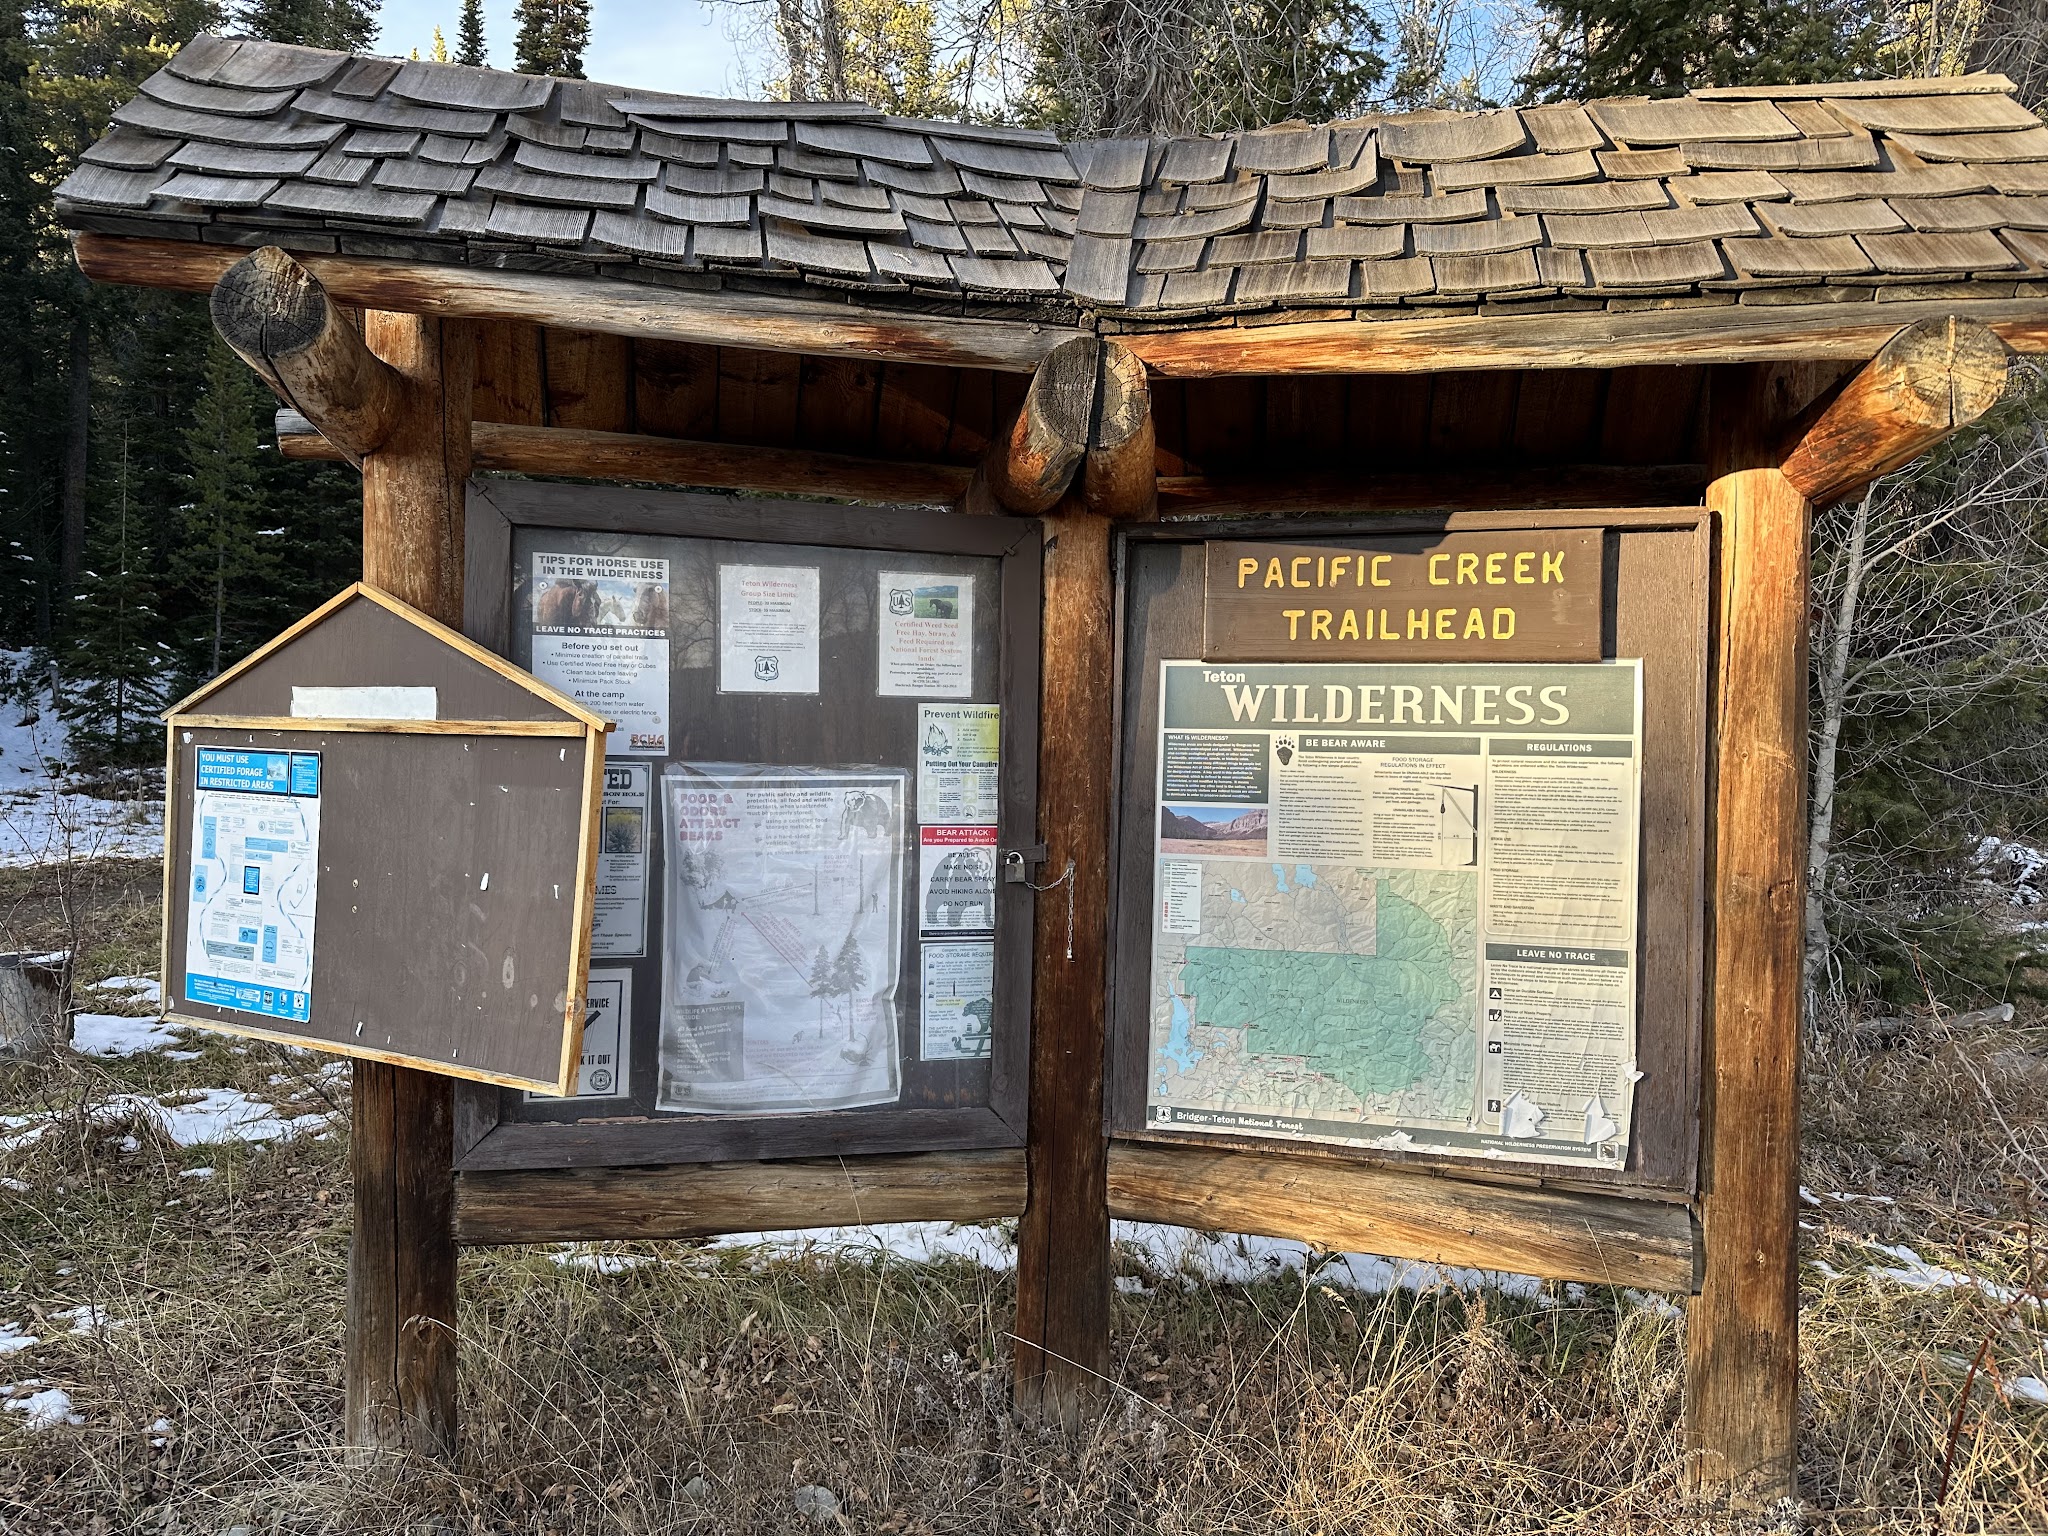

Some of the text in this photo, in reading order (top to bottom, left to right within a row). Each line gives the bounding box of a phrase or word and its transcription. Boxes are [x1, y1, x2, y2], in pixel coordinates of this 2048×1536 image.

[538, 556, 664, 570] TIPS FOR HORSE USE
[542, 566, 664, 580] IN THE WILDERNESS
[1238, 550, 1565, 588] PACIFIC CREEK
[1282, 607, 1516, 641] TRAILHEAD
[1203, 670, 1246, 683] Teton
[1221, 684, 1570, 726] WILDERNESS
[924, 710, 960, 719] Prevent
[1350, 740, 1386, 748] AWARE
[1527, 743, 1592, 752] REGULATIONS
[202, 753, 249, 764] YOU MUST USE
[201, 765, 263, 776] CERTIFIED FORAGE
[201, 777, 274, 790] IN RESTRICTED AREAS
[681, 794, 733, 804] FOOD &
[680, 806, 727, 816] ODORS
[680, 818, 740, 828] ATTRACT
[680, 831, 723, 841] BEARS
[1517, 949, 1545, 958] LEAVE
[1564, 952, 1596, 960] TRACE
[586, 998, 609, 1008] ERVICE
[588, 1055, 595, 1065] IT
[598, 1055, 610, 1064] OUT
[1177, 1112, 1303, 1130] Bridger-Teton National Forest
